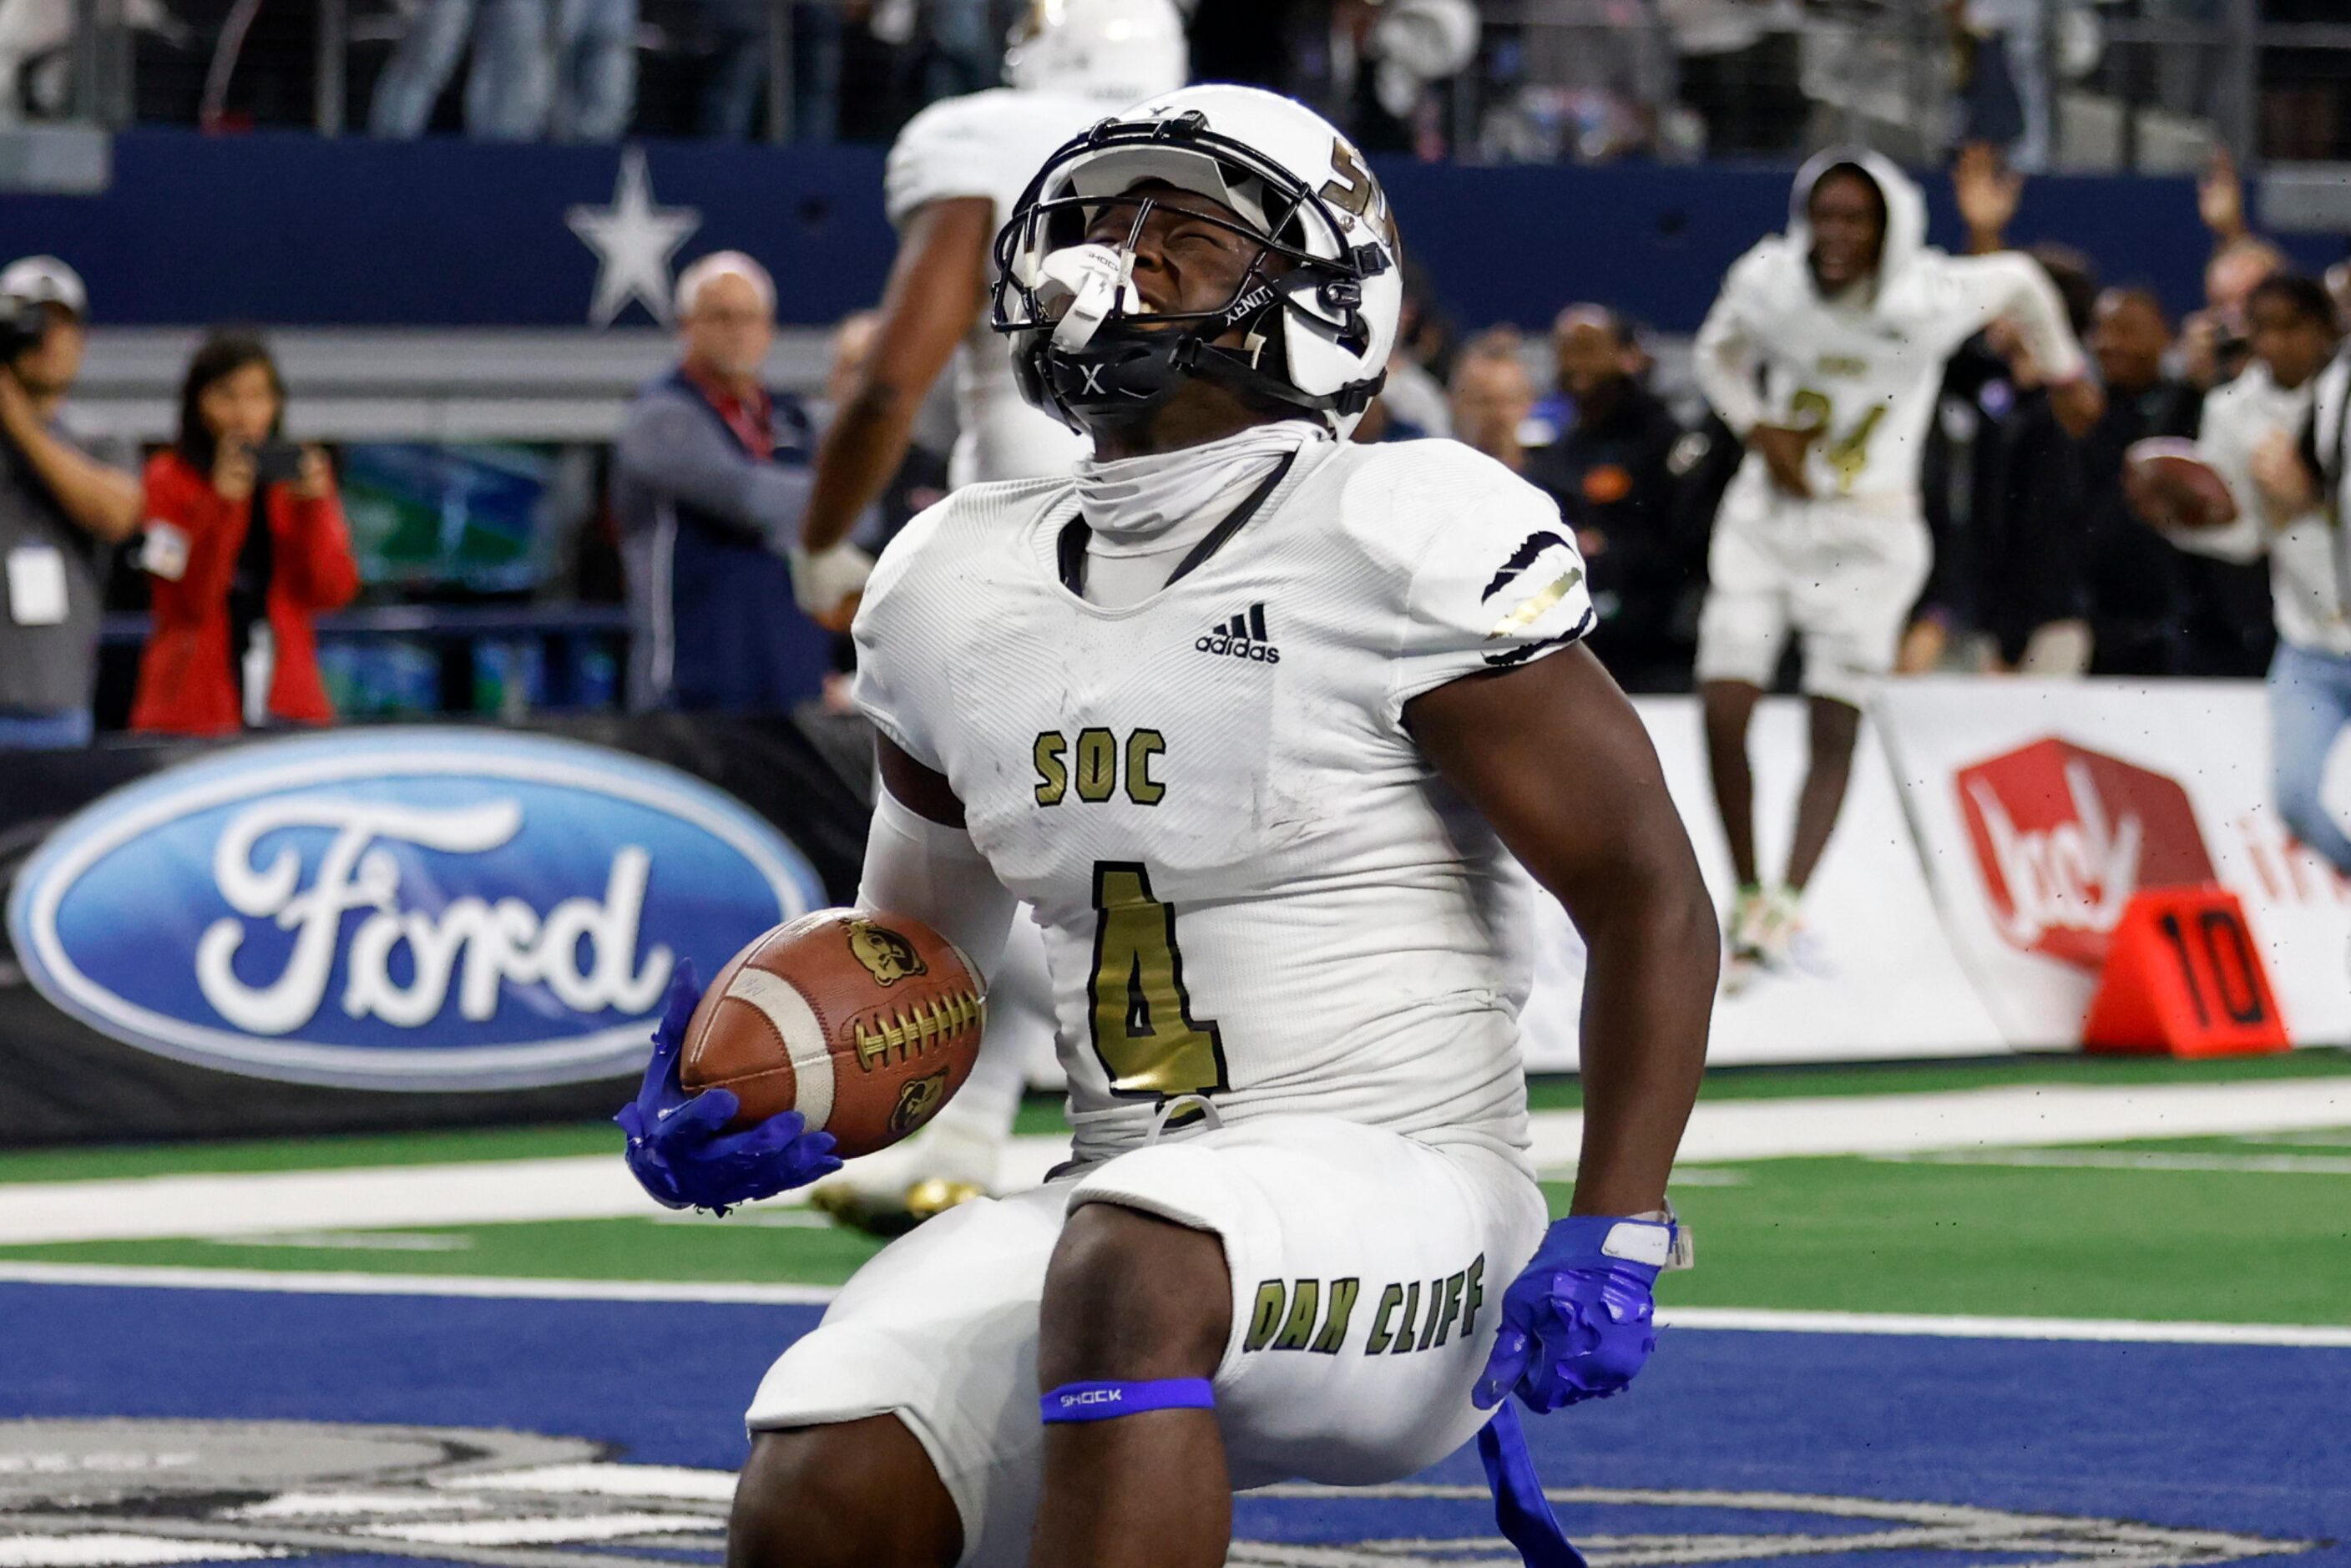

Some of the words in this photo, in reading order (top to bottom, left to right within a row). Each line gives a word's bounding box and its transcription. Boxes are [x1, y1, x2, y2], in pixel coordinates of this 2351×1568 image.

[1195, 635, 1281, 664] adidas
[1033, 727, 1166, 807] SOC
[195, 795, 675, 1036] Ford
[1088, 860, 1231, 1125] 4
[2161, 910, 2265, 1027] 10
[1364, 1252, 1484, 1356] CLIFF
[1060, 1389, 1121, 1408] SHOCK
